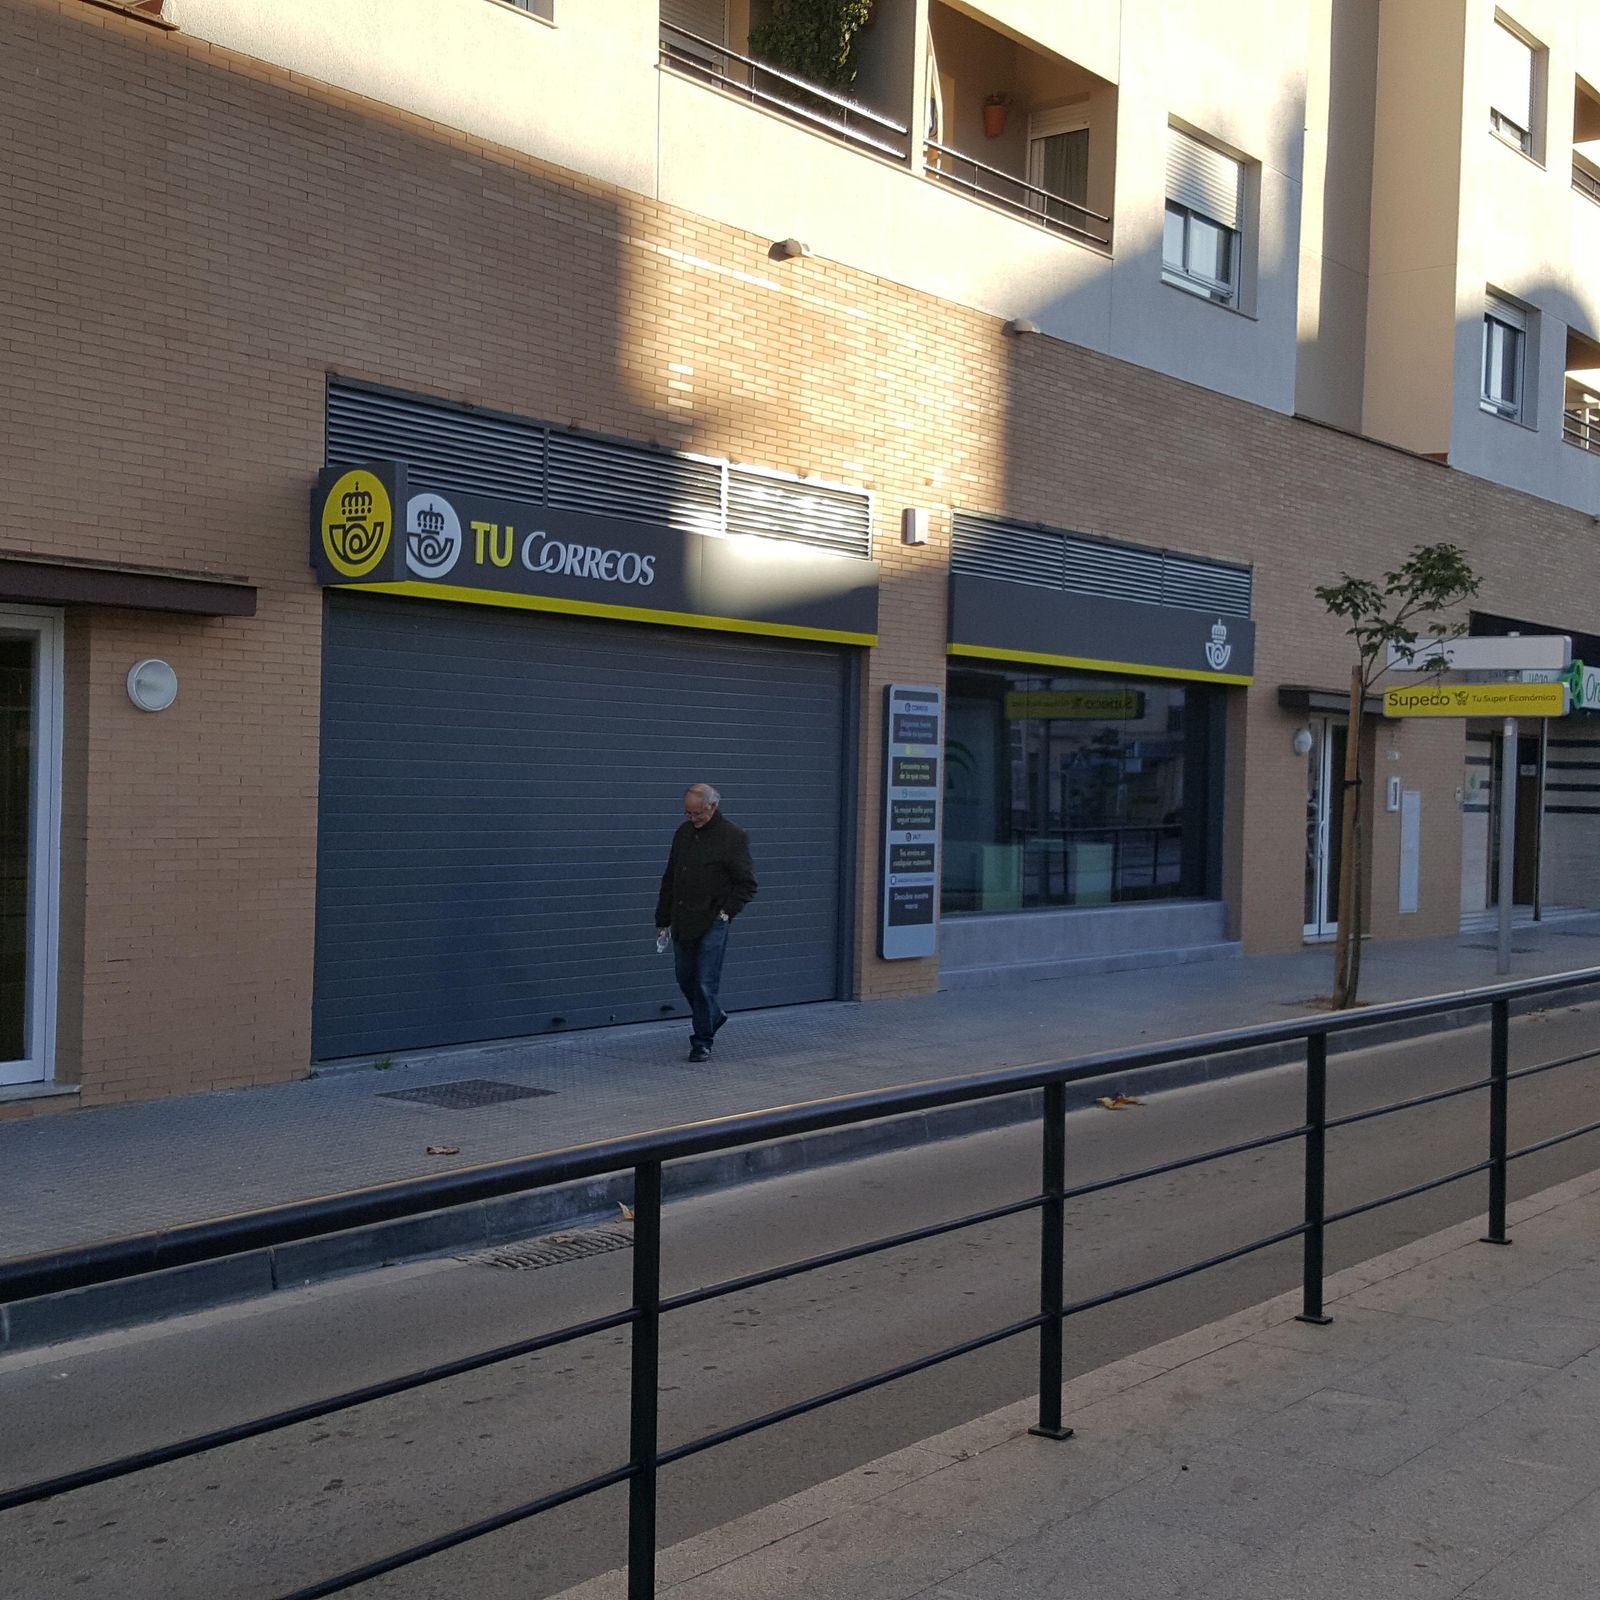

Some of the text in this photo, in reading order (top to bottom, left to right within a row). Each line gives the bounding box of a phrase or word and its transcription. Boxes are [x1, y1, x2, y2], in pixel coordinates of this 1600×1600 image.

[470, 520, 656, 586] TU CORREOS
[1388, 693, 1450, 710] Supeco
[1483, 695, 1508, 704] Super
